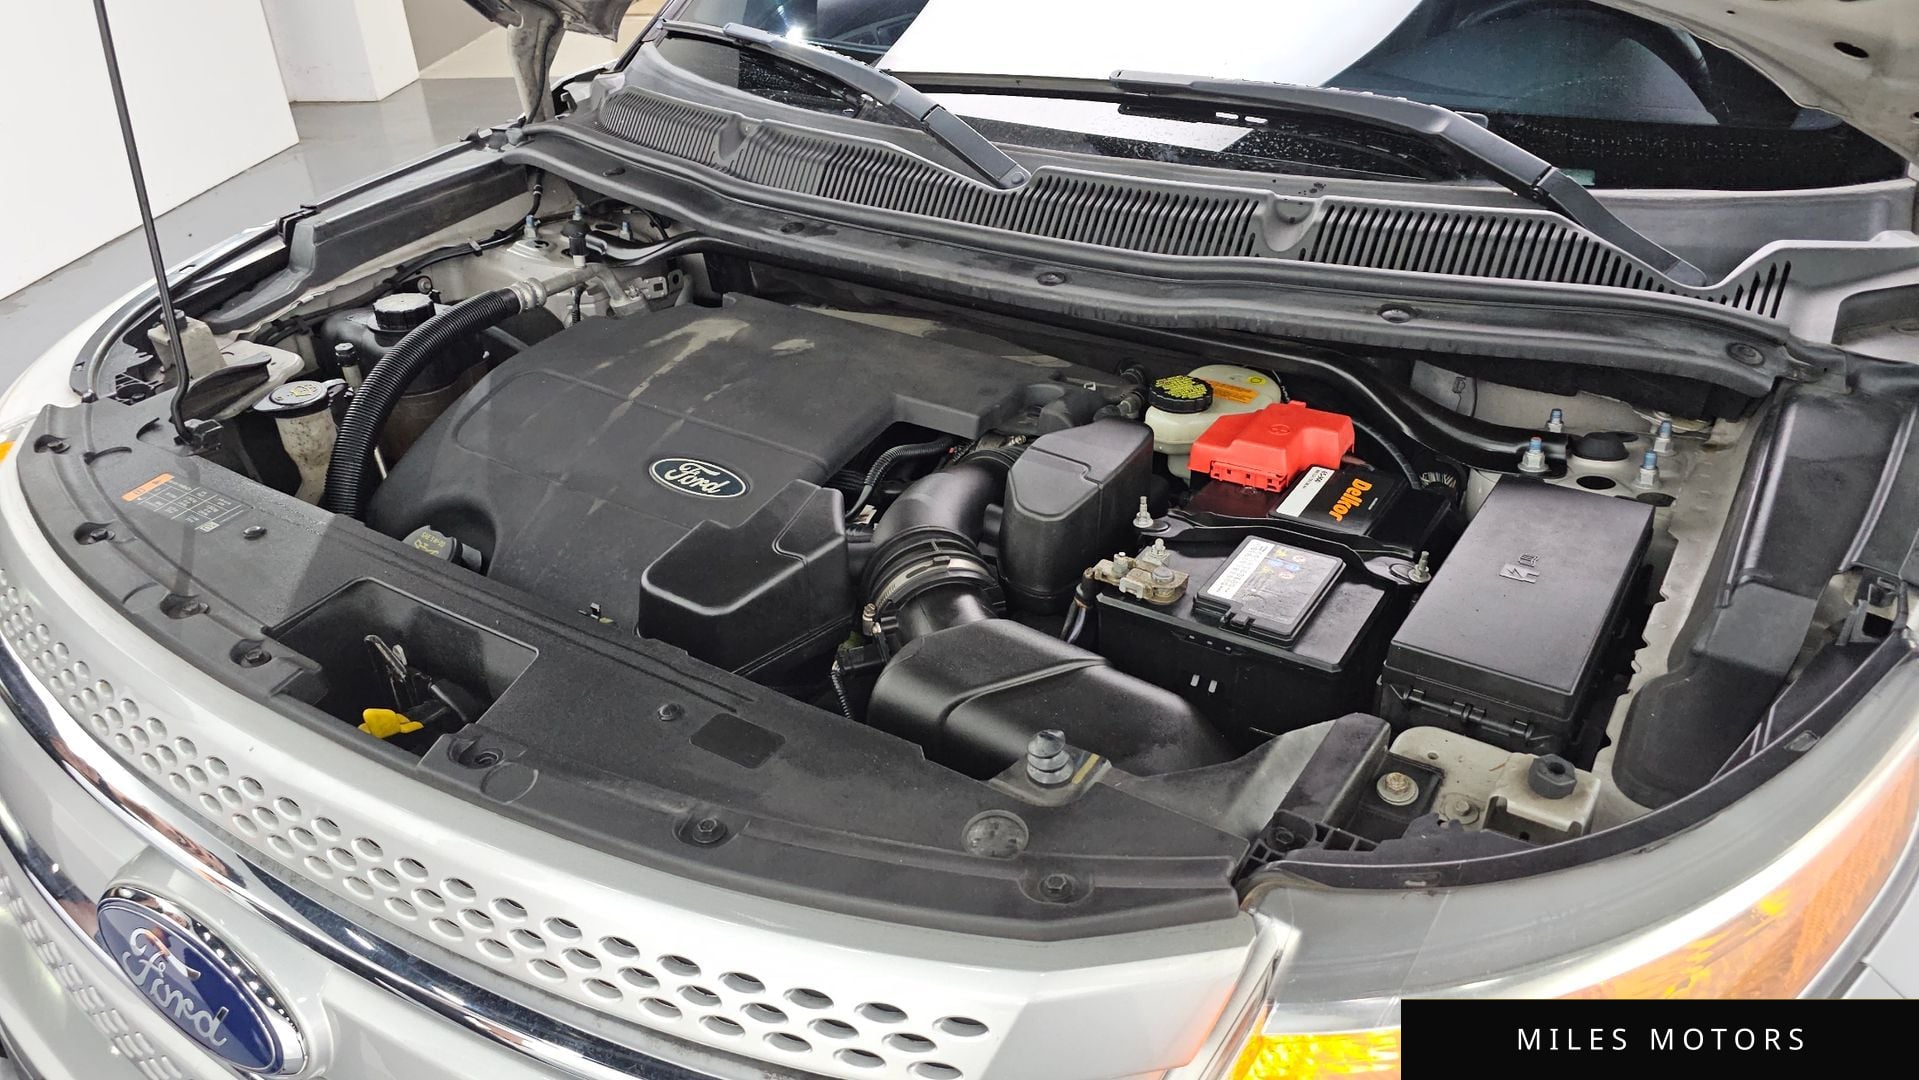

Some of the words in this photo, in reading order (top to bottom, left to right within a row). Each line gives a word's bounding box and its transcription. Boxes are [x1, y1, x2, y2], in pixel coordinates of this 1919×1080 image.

[664, 462, 731, 493] Ford
[1328, 478, 1373, 522] Delkor
[122, 927, 230, 1047] Ford
